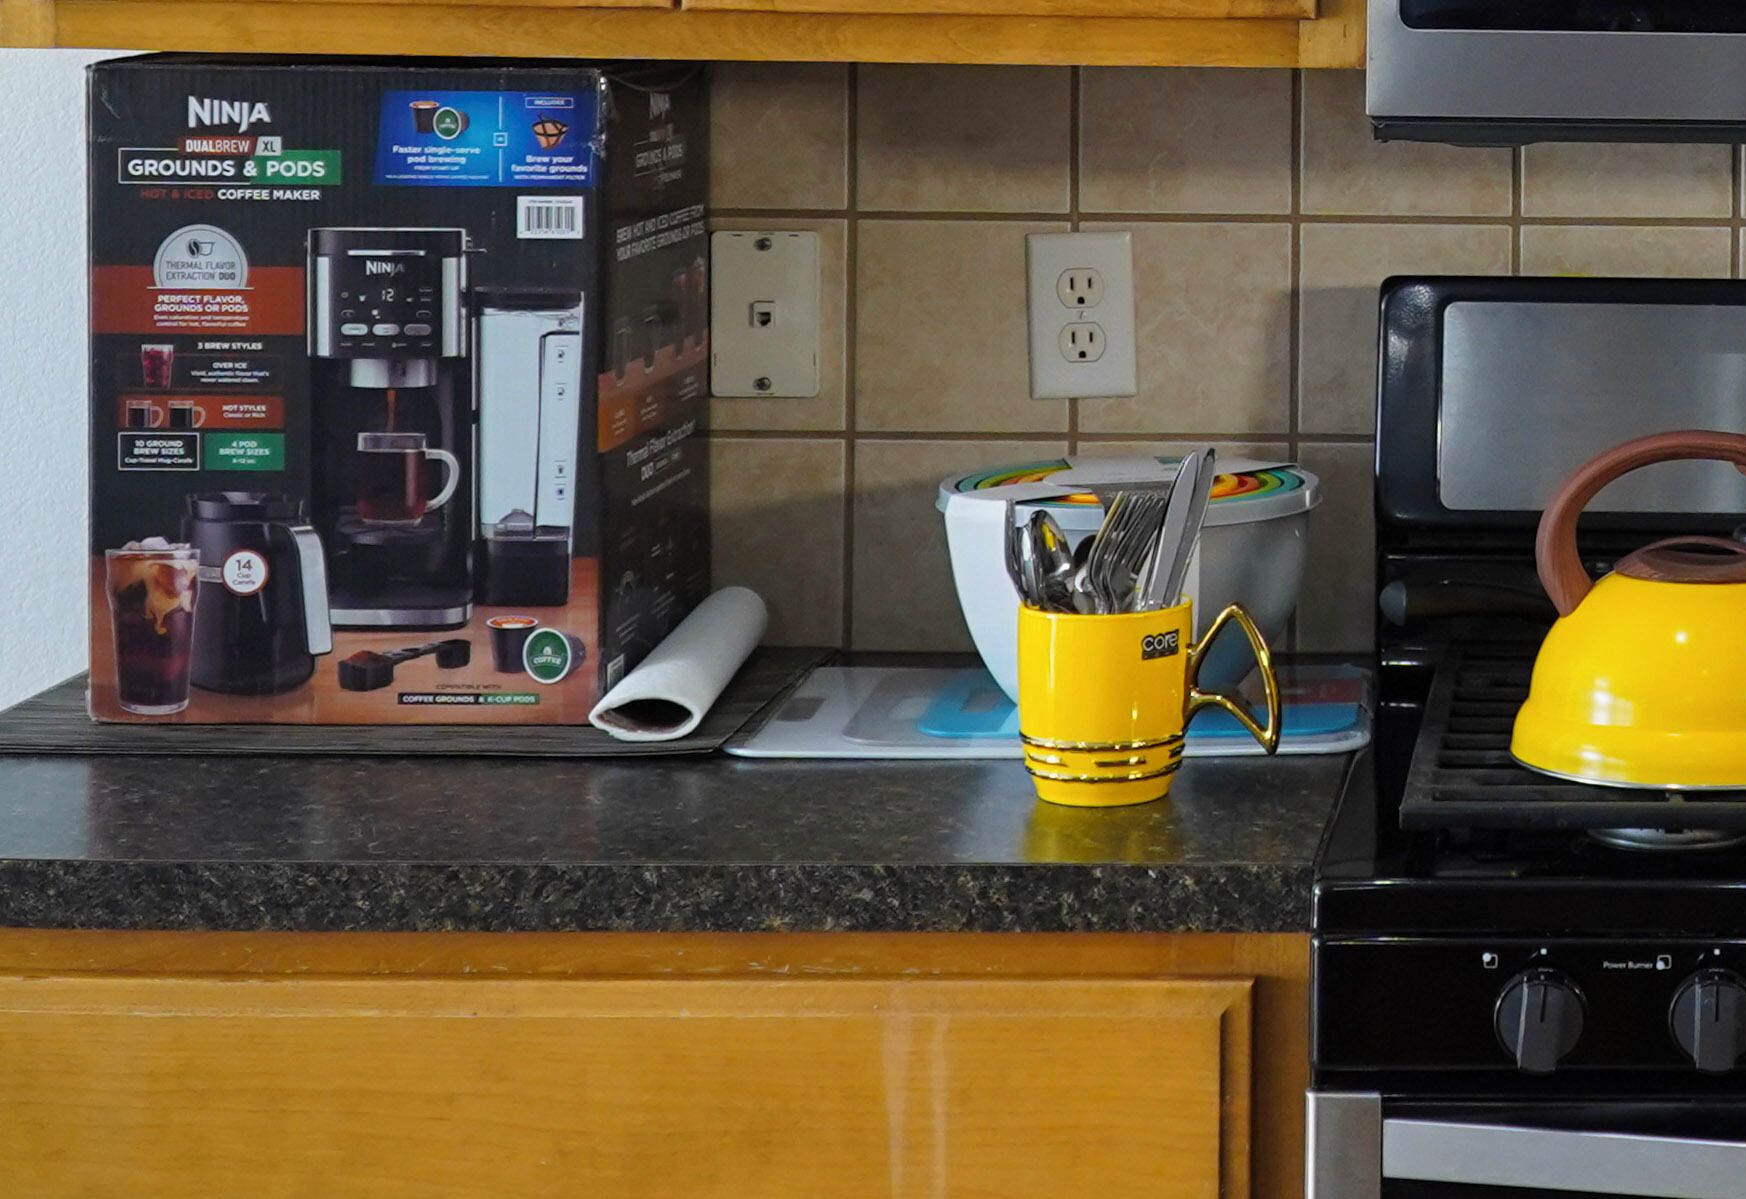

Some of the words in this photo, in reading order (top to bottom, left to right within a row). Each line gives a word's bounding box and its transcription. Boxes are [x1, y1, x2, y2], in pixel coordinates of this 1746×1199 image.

[187, 95, 272, 133] NINJA
[185, 138, 250, 154] DUALBREW
[262, 138, 277, 153] XL
[392, 145, 421, 154] Faster
[407, 155, 426, 165] pod
[428, 155, 467, 165] brewing
[526, 155, 550, 163] Brew
[551, 156, 574, 164] your
[127, 159, 235, 177] GROUNDS
[242, 160, 258, 178] &
[266, 161, 325, 178] PODS
[511, 164, 547, 173] favorite
[549, 164, 588, 174] grounds
[140, 189, 168, 199] HOT
[171, 189, 180, 199] &
[184, 189, 214, 200] ICED
[217, 189, 270, 200] COFFEE
[273, 189, 320, 201] MAKER
[166, 260, 202, 270] THERMAL
[205, 260, 236, 270] FLAVOR
[365, 260, 405, 277] NINJA
[166, 272, 215, 281] EXTRACTION
[218, 272, 236, 281] DUO
[157, 294, 201, 303] PERFECT
[203, 295, 245, 304] FLAVOR,
[381, 288, 395, 302] 12
[154, 303, 203, 312] GROUNDS
[204, 304, 219, 312] OR
[221, 304, 249, 313] PODS
[197, 342, 203, 350] 3
[204, 342, 230, 350] BREW
[231, 342, 262, 350] STYLES
[146, 440, 184, 448] GROUND
[231, 440, 238, 448] 4
[133, 447, 159, 456] BREW
[160, 448, 185, 456] SIZES
[218, 448, 244, 456] BREW
[245, 448, 270, 456] SIZES
[235, 559, 253, 571] 14
[1142, 633, 1178, 652] core
[532, 655, 562, 666] COFFEE
[402, 695, 434, 704] COFFEE
[435, 695, 475, 704] GROUNDS
[487, 695, 512, 704] K-CUP
[513, 696, 536, 704] PODS
[1603, 961, 1627, 970] Power
[1628, 961, 1654, 970] Burner
